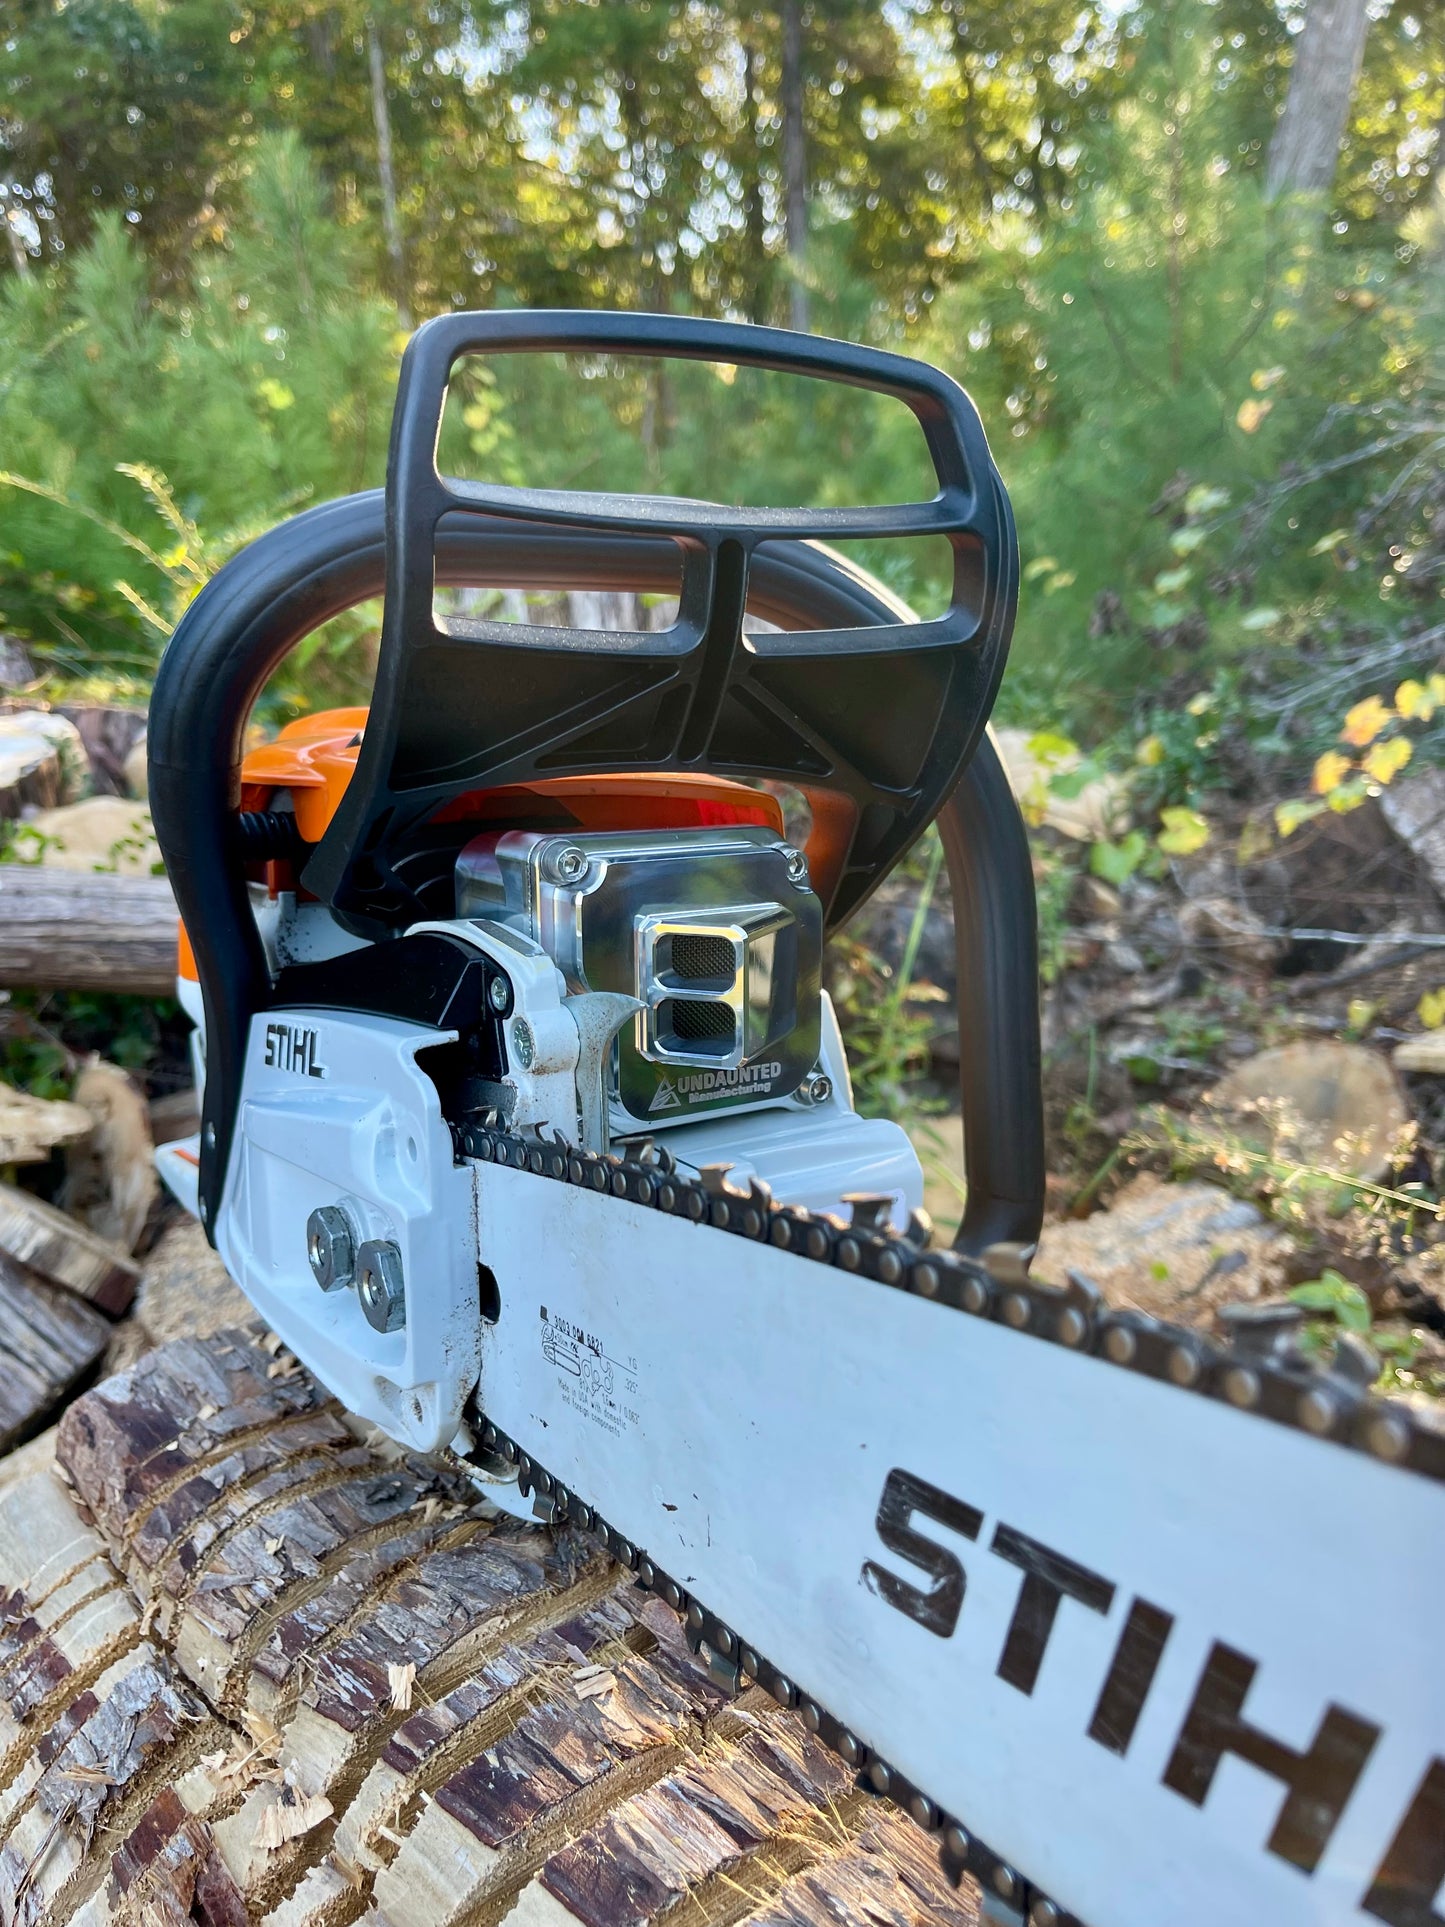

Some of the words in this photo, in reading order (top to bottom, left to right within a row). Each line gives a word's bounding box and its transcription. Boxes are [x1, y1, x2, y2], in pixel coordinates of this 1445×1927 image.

[265, 1024, 326, 1080] STIHL
[677, 1061, 782, 1094] UNDAUNTED
[688, 1081, 772, 1104] Manufacturing
